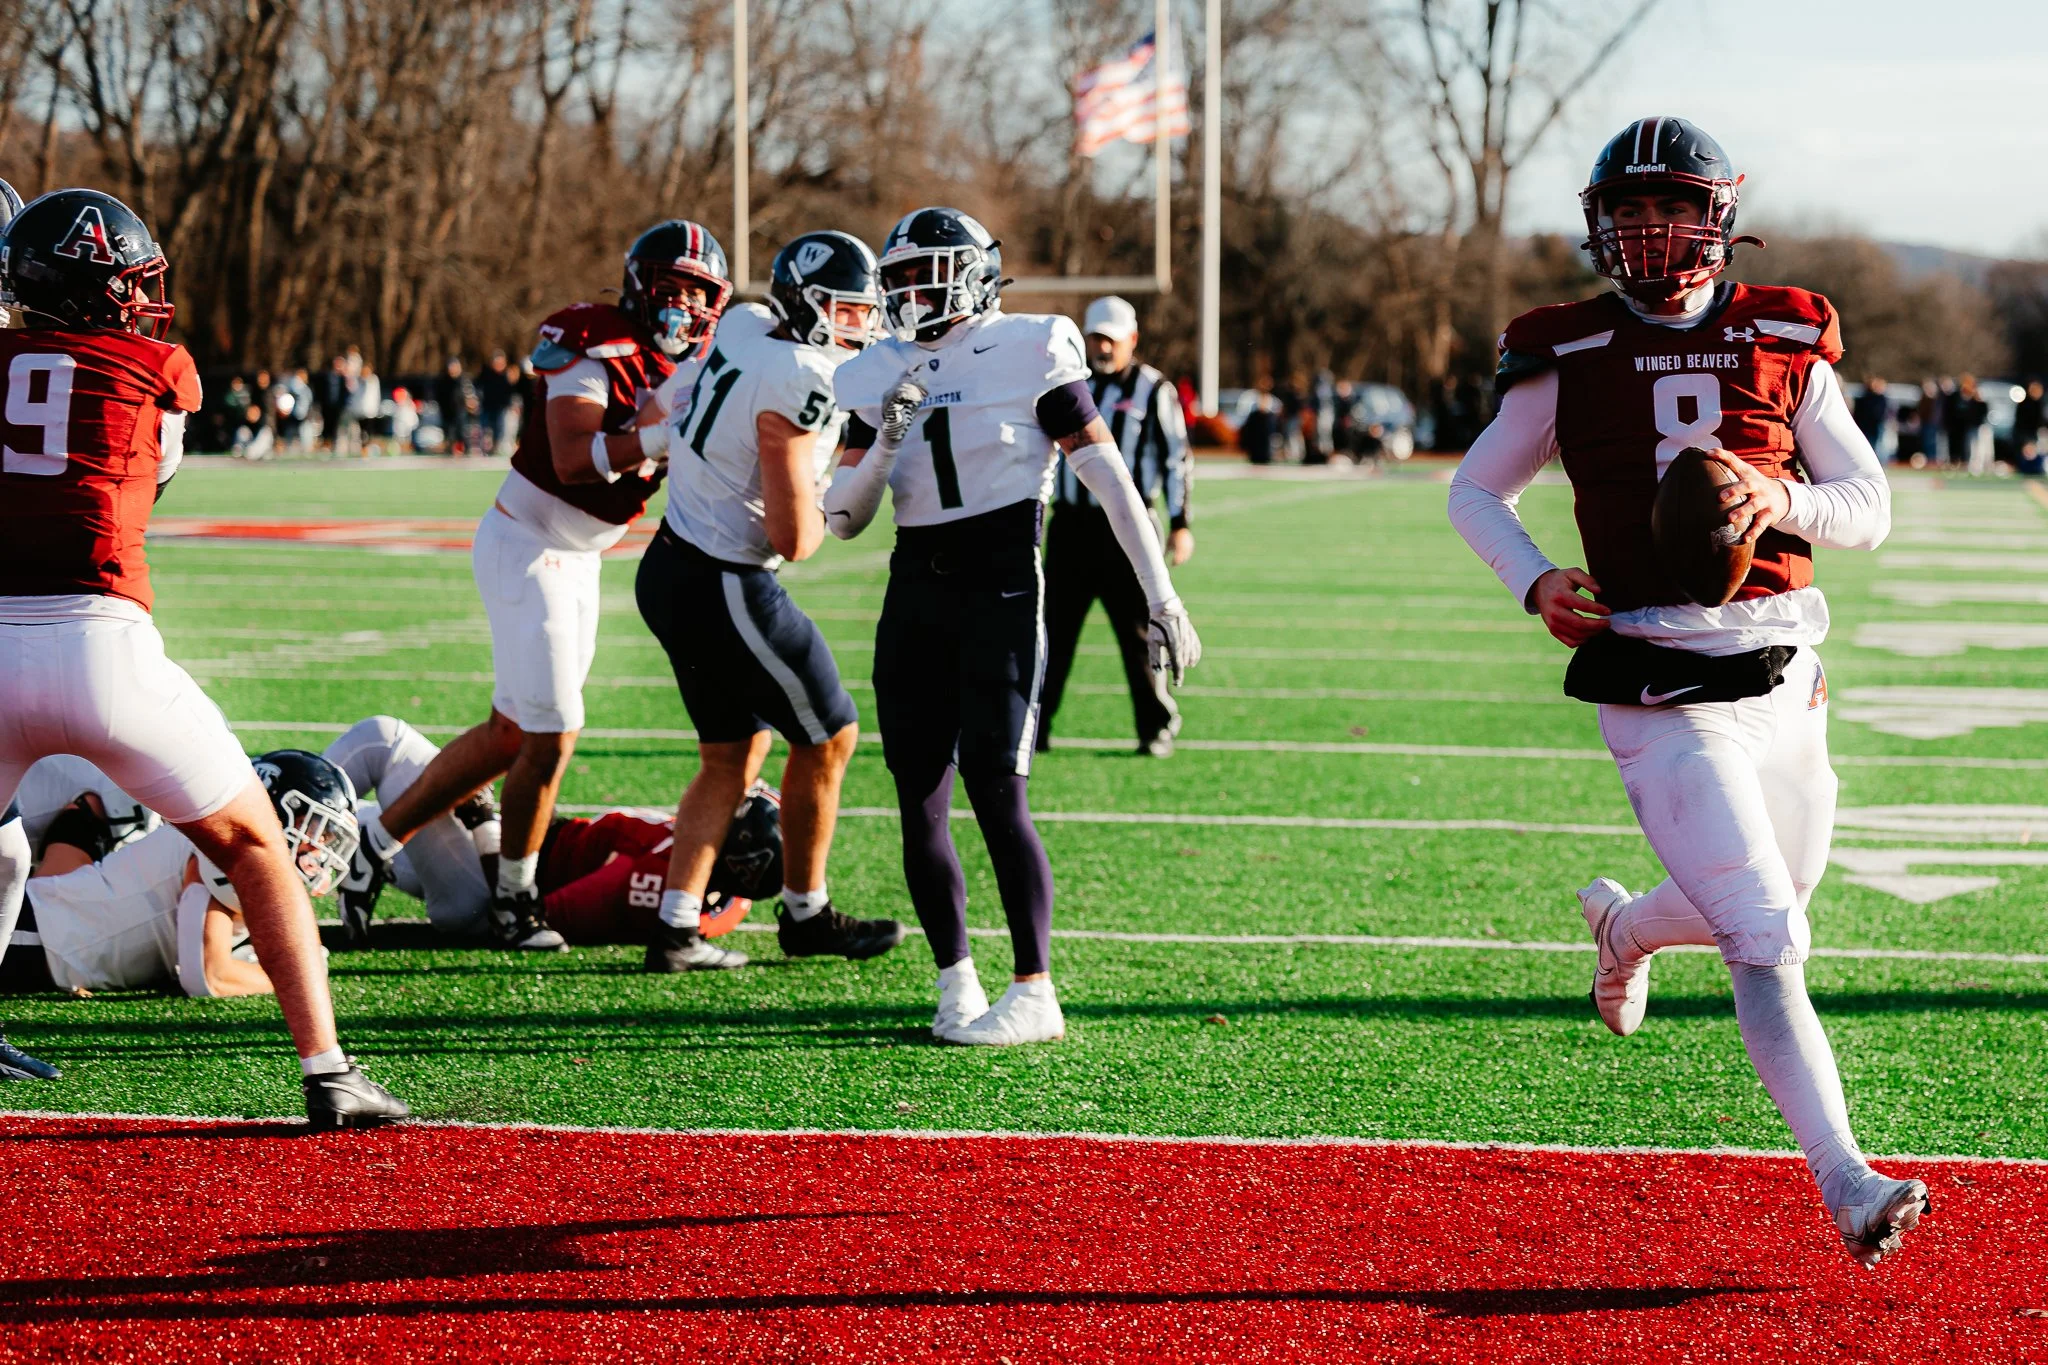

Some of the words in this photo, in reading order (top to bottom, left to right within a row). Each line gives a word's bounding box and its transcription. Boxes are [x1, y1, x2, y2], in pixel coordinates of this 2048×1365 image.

[1625, 163, 1666, 174] Riddell
[54, 205, 115, 266] A
[804, 245, 825, 264] W
[1634, 355, 1682, 372] WINGED
[1686, 353, 1740, 369] BEAVERS
[2, 353, 78, 476] 9
[1653, 372, 1723, 483] 8
[922, 406, 964, 510] 1
[1807, 661, 1829, 711] A
[629, 871, 663, 909] 58
